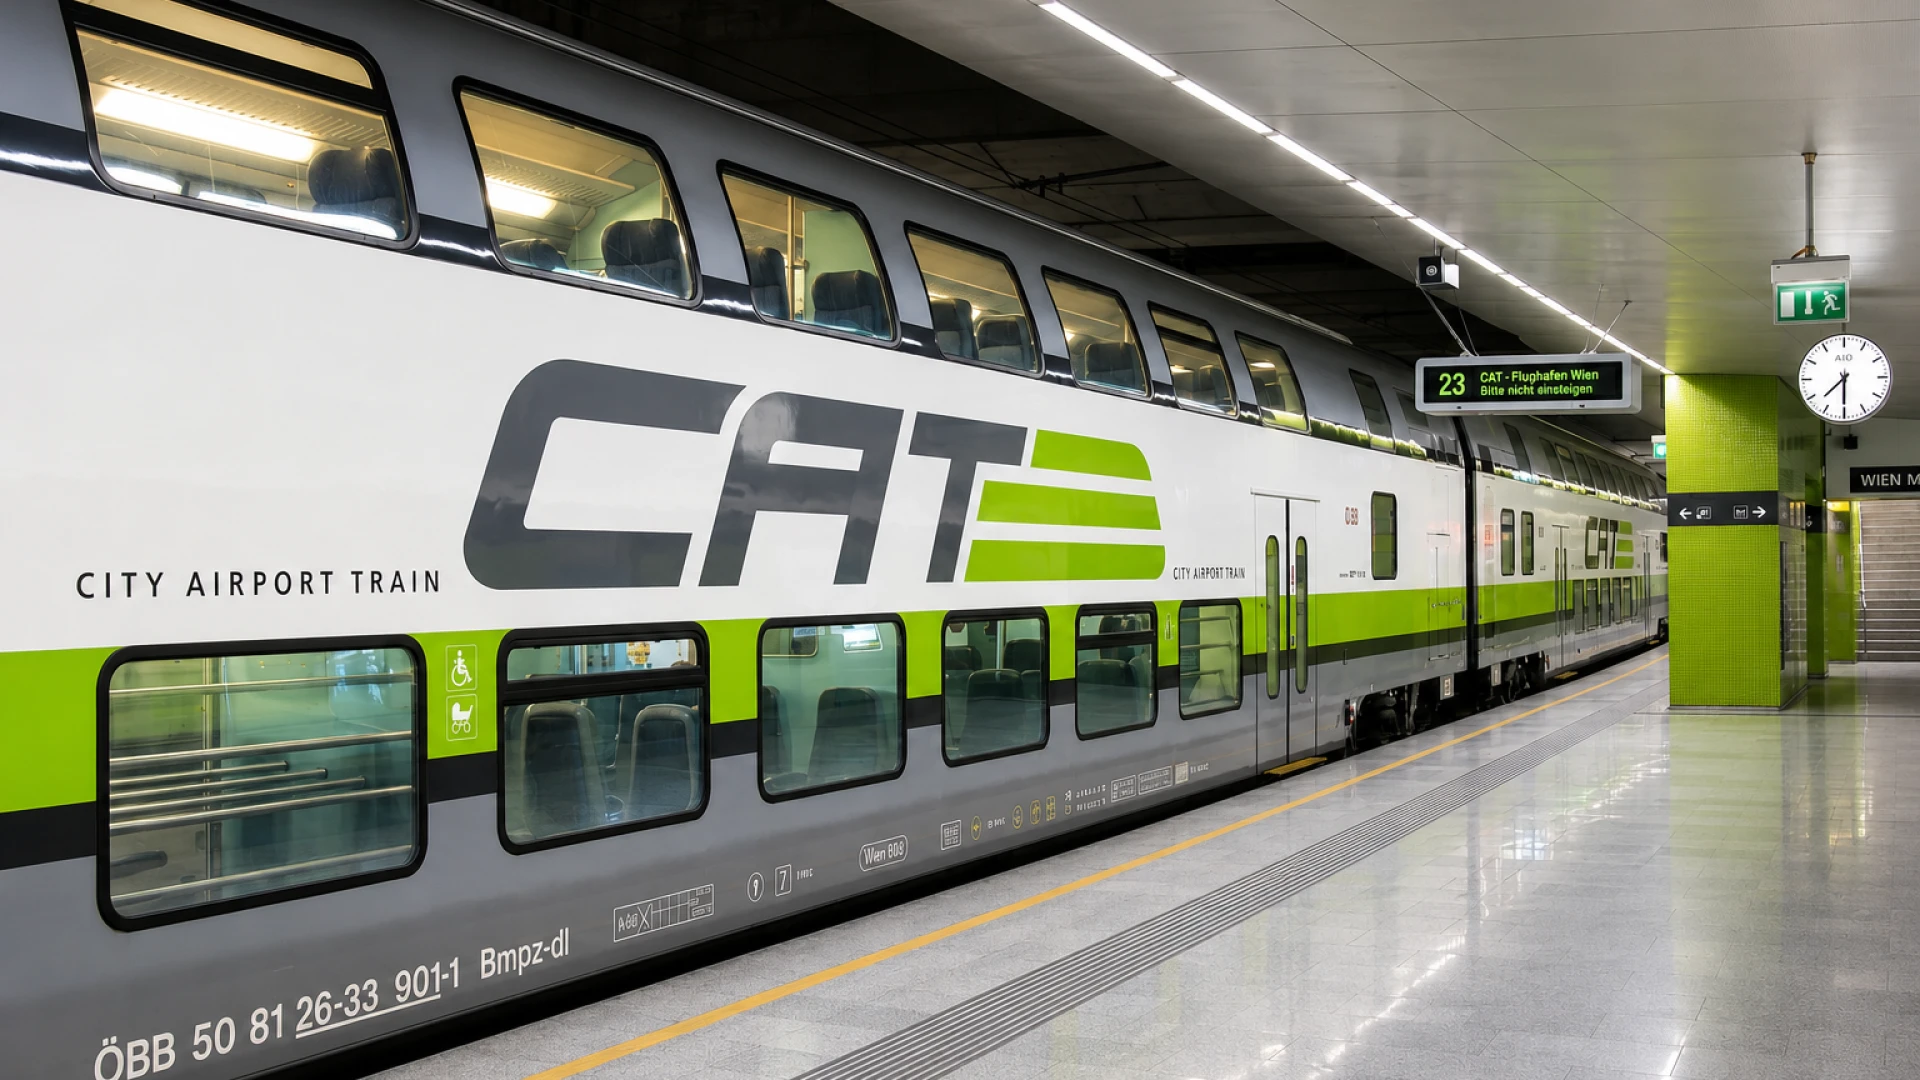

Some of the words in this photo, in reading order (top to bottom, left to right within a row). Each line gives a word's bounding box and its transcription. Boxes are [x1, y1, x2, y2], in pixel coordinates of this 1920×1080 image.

[1439, 372, 1466, 396] 23
[1480, 371, 1503, 383] CAT
[1511, 368, 1568, 385] Flughafen
[1570, 368, 1599, 381] Wien
[1480, 385, 1505, 396] Bitte
[1508, 384, 1535, 396] nicht
[1537, 382, 1594, 397] einsteigen
[463, 358, 1028, 591] CAT
[1860, 473, 1901, 487] WIEN
[1173, 566, 1191, 580] CITY
[1193, 566, 1224, 580] AIRPORT
[1225, 566, 1246, 580] TRAIN
[75, 571, 164, 600] CITY
[186, 570, 334, 597] AIRPORT
[351, 569, 440, 594] TRAIN
[94, 1032, 176, 1080] ÖBB
[192, 1016, 236, 1061] 50
[249, 1003, 283, 1045] 81
[296, 979, 379, 1032] 26-33
[395, 957, 460, 1003] 901-1
[480, 927, 570, 980] Bmpz-dl
